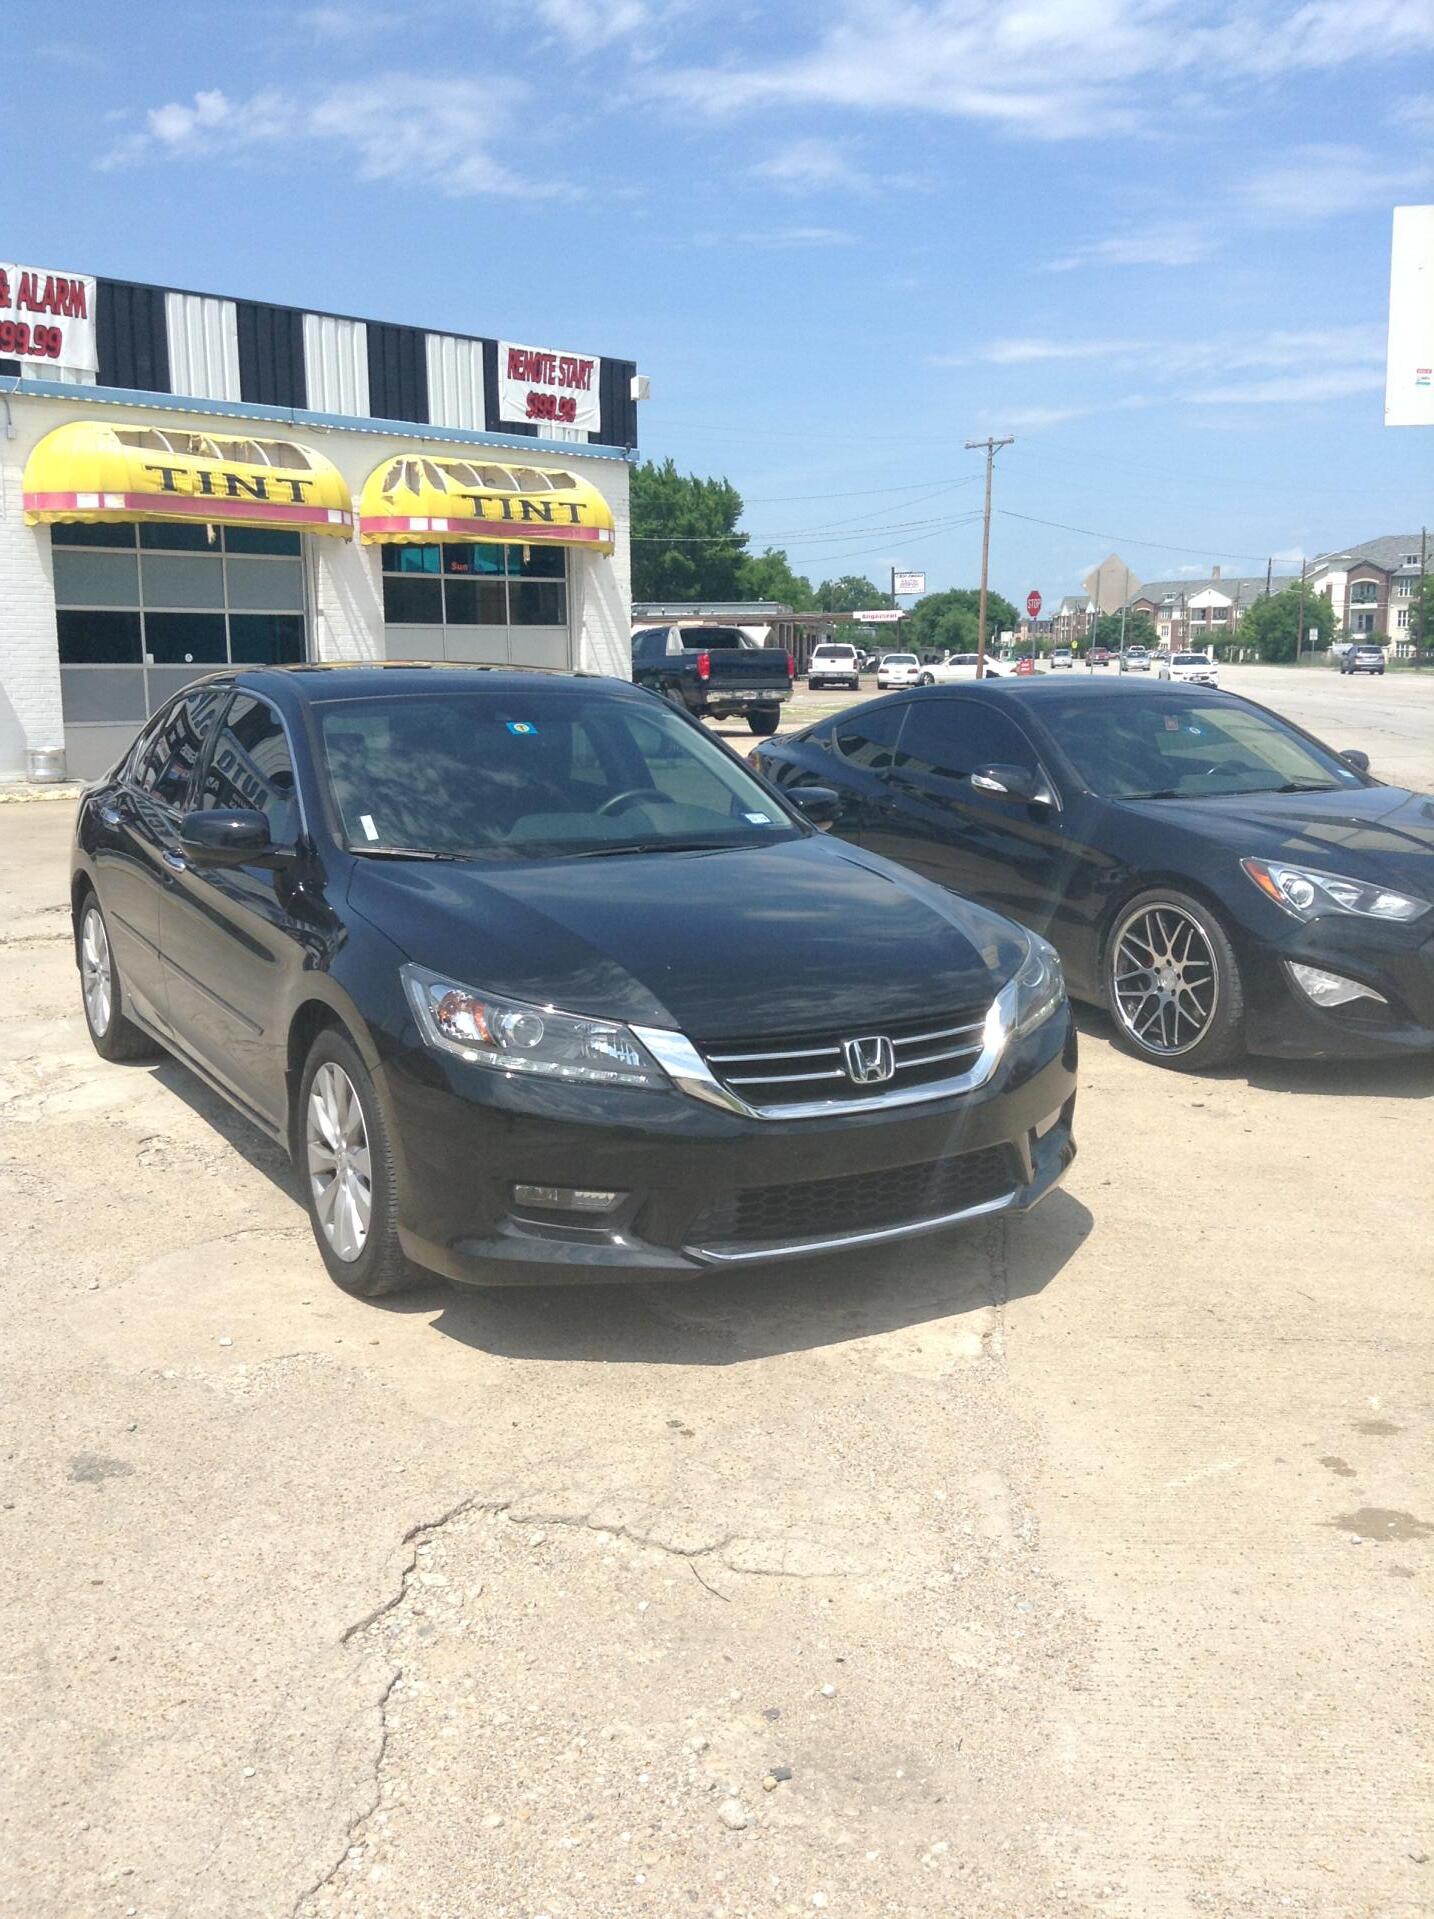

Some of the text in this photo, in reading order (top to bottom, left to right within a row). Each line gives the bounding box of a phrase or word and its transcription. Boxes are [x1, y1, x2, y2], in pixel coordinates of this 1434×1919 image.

[16, 271, 88, 320] ALARM
[0, 319, 63, 359] 99.99
[507, 347, 595, 391] REMOTE START
[525, 390, 577, 423] $199.99
[145, 465, 313, 503] TINT
[462, 495, 587, 523] TINT
[1027, 598, 1041, 609] STOP
